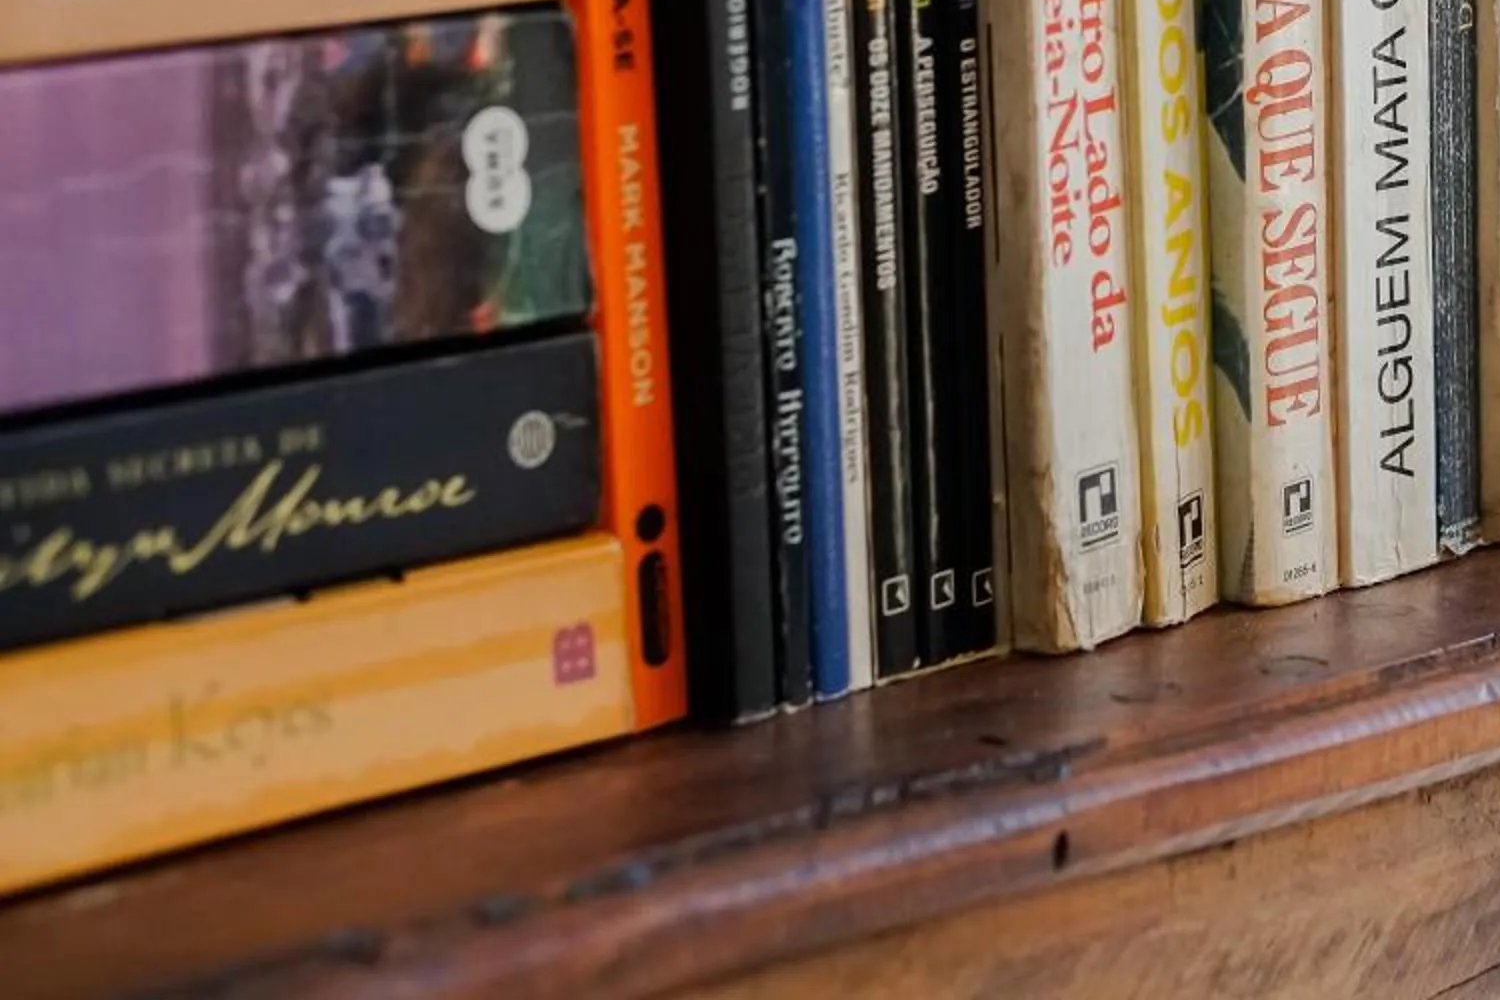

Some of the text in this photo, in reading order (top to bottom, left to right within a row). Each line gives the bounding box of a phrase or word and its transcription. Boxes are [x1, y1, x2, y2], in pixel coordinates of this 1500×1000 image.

[867, 37, 896, 291] OS DOZE MANDAMENTOS
[915, 37, 941, 195] A PERSEGUIÇÃO
[960, 38, 983, 230] O ESTRANGULADOR
[1082, 86, 1121, 259] Lado
[1246, 48, 1315, 194] QUE
[1372, 26, 1410, 192] MATA
[615, 125, 653, 407] MARK MANSON
[1090, 268, 1127, 353] da
[1159, 170, 1204, 448] ANJOS
[1260, 201, 1323, 429] SEGUE
[1375, 213, 1415, 477] ALGUEM
[1080, 515, 1119, 540] RECORD
